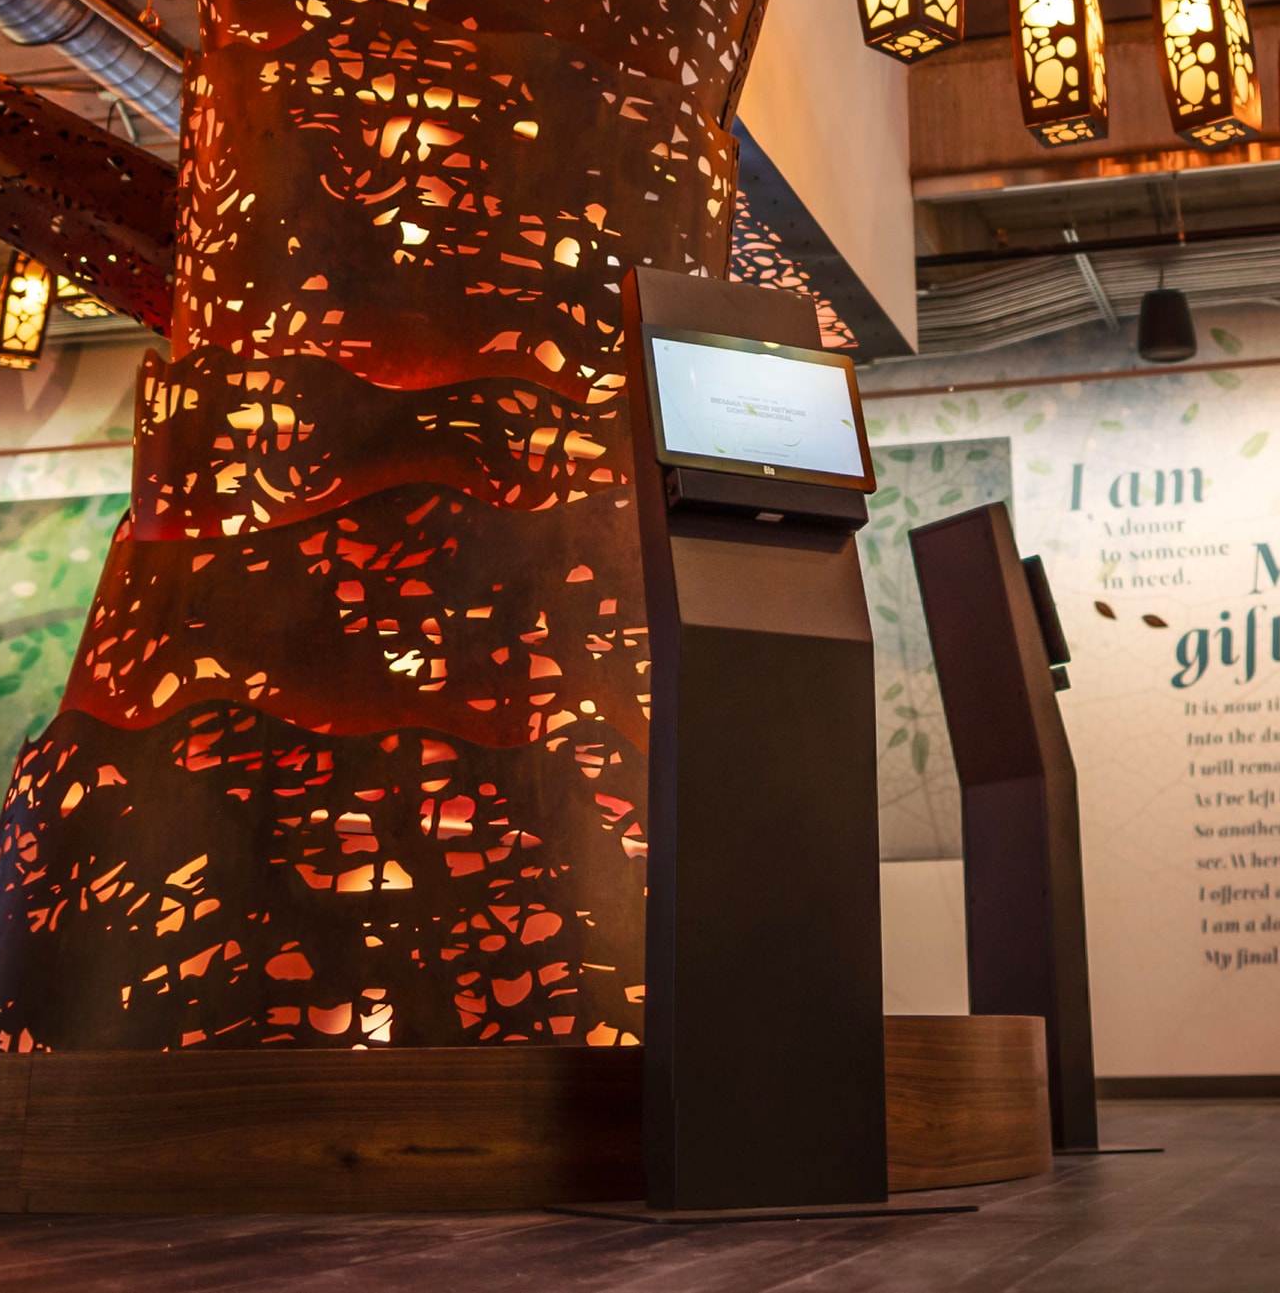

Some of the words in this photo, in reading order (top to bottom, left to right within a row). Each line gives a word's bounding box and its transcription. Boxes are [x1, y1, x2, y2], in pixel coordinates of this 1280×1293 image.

[1070, 462, 1084, 511] I
[1109, 466, 1204, 509] am
[1120, 517, 1185, 536] donor
[1101, 548, 1121, 564] to
[1129, 542, 1230, 561] someone
[1102, 572, 1124, 590] in
[1132, 566, 1192, 589] need.
[1185, 701, 1197, 716] It
[1203, 699, 1218, 715] is
[1224, 701, 1261, 714] now
[1187, 731, 1223, 746] Into
[1228, 727, 1256, 744] the
[1200, 759, 1234, 776] will
[1195, 792, 1212, 807] As
[1216, 791, 1245, 806] I've
[1249, 788, 1275, 809] left
[1194, 824, 1214, 838] So
[1209, 882, 1270, 905] offered
[1212, 920, 1240, 934] am
[1245, 919, 1256, 933] a
[1205, 949, 1232, 971] My
[1236, 945, 1278, 970] final
